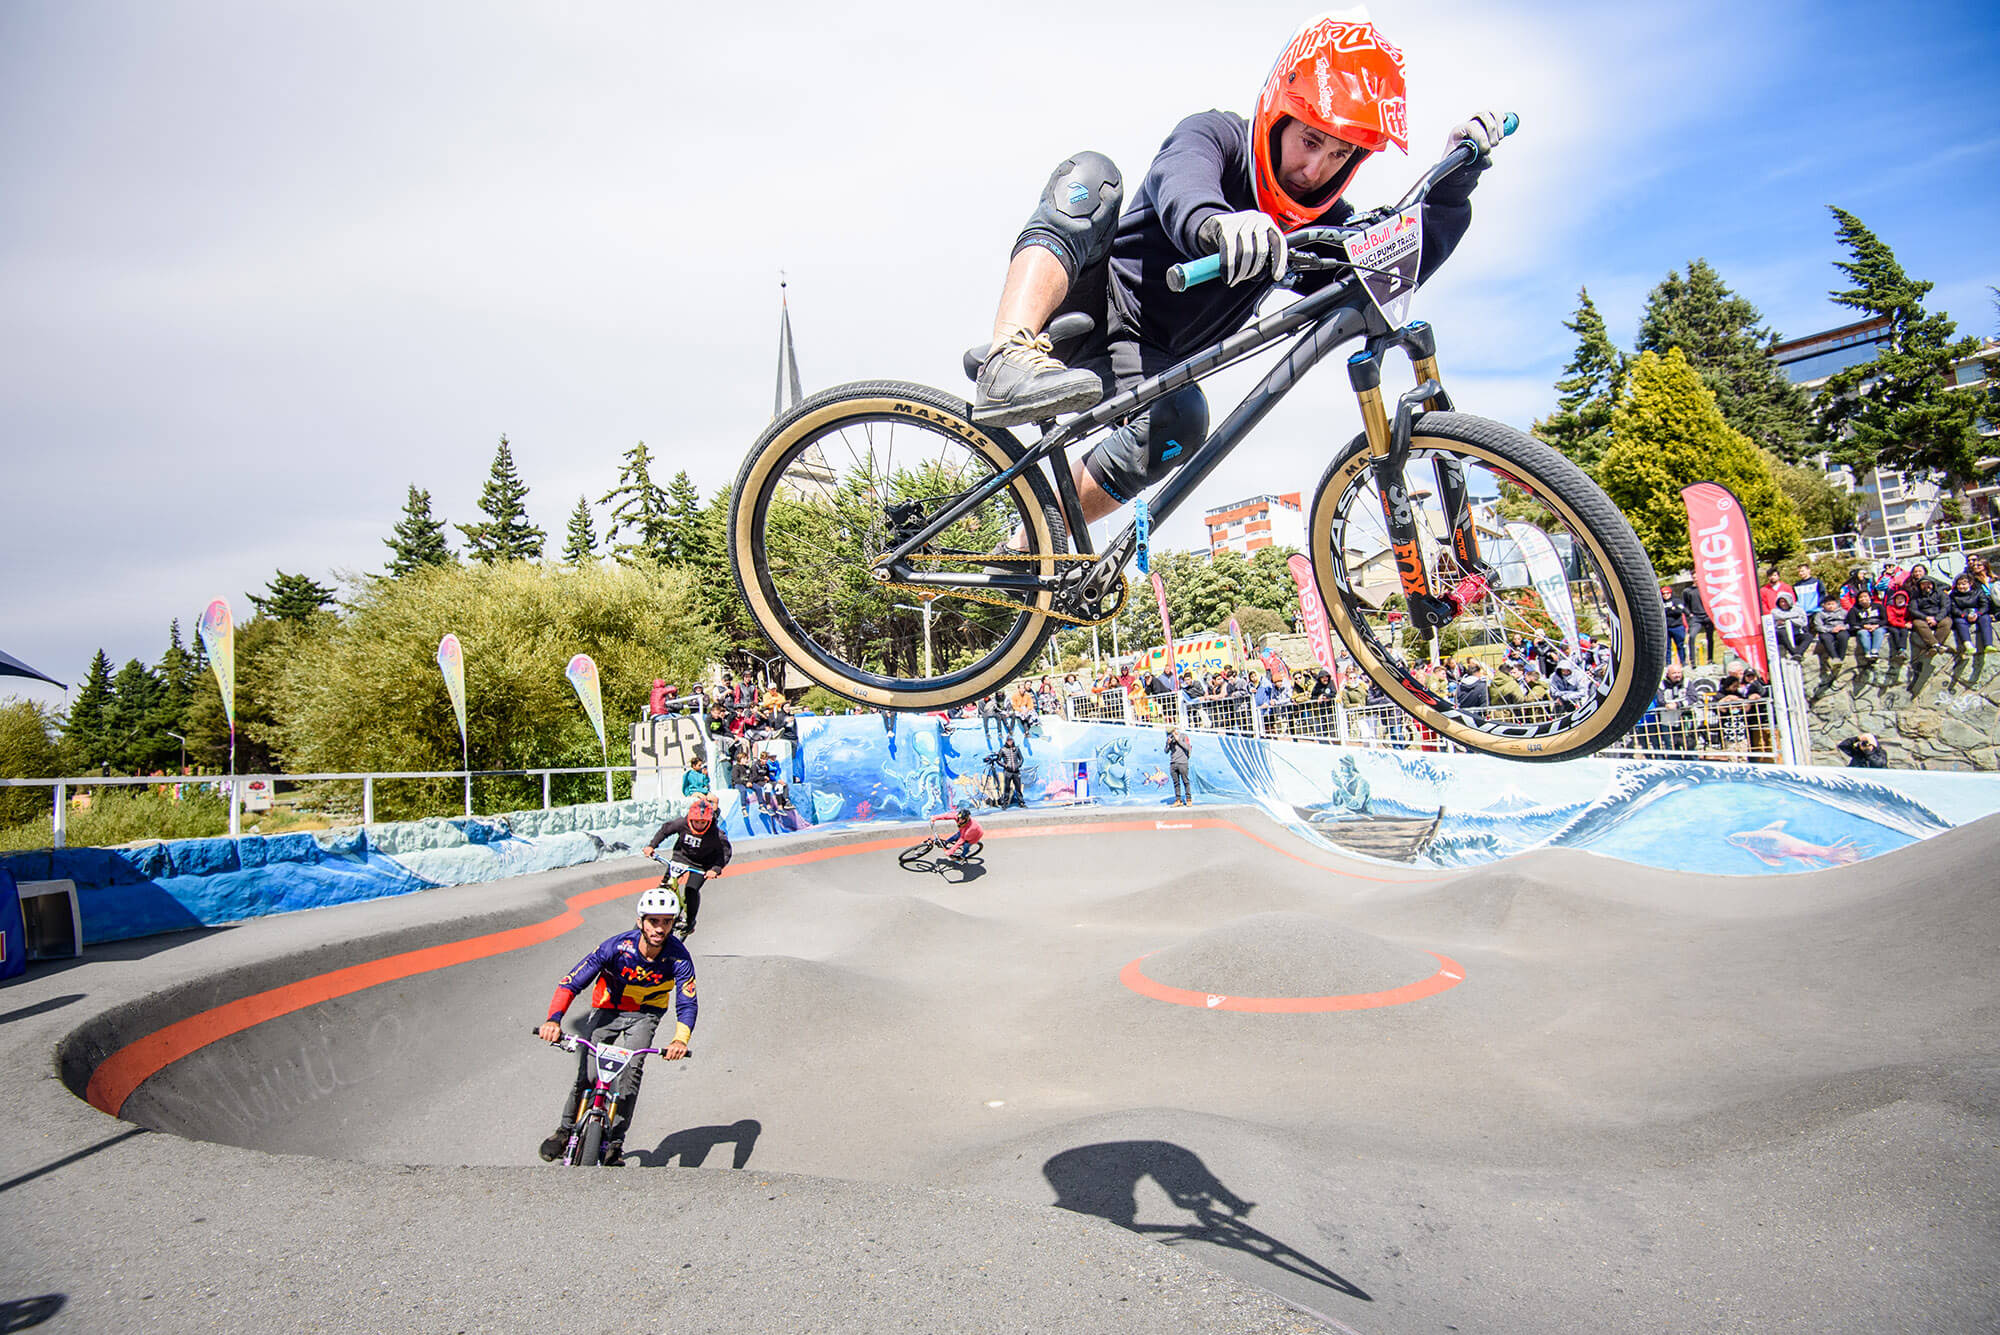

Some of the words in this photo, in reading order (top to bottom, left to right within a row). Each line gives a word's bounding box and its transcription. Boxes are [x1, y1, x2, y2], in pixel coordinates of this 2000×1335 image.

[1351, 238, 1371, 257] Red
[1370, 226, 1391, 247] Bull
[1362, 252, 1377, 265] UCI
[1377, 242, 1397, 258] PUMP
[1397, 231, 1417, 248] TRACK
[1388, 266, 1402, 293] 3
[893, 403, 988, 448] MAXXIS
[1392, 539, 1427, 599] FOX
